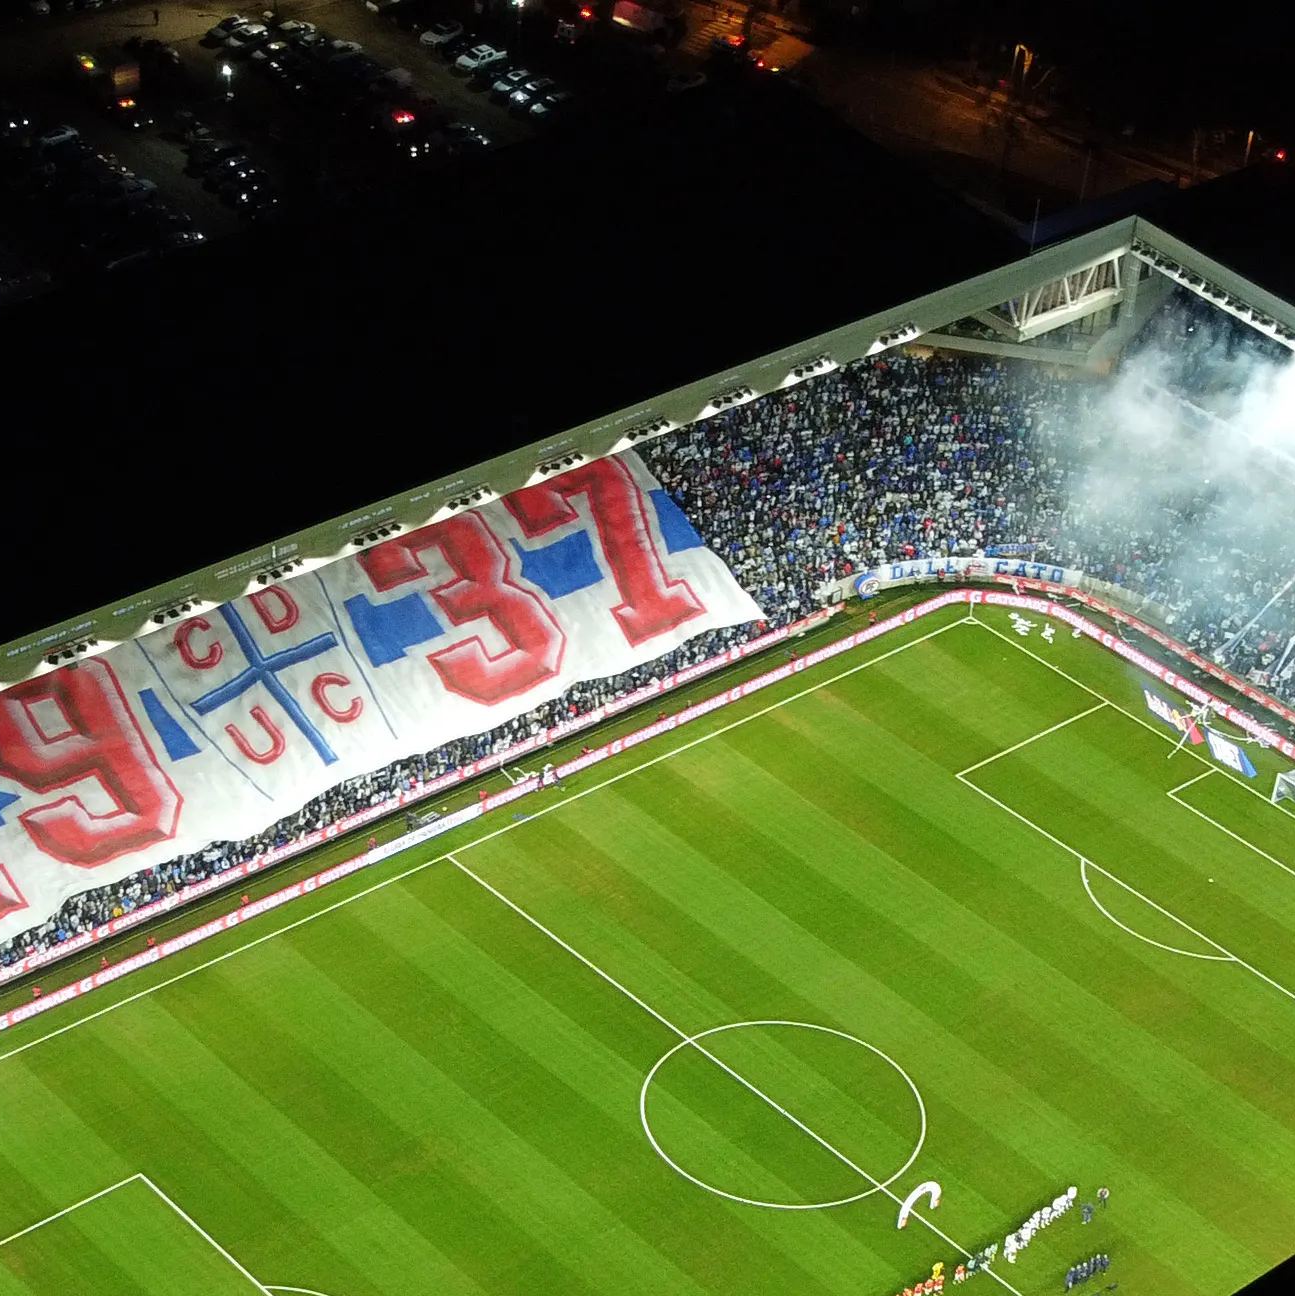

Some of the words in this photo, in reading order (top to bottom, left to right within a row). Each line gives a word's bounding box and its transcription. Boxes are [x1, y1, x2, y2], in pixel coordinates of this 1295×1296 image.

[969, 591, 982, 604] G
[1102, 630, 1114, 647] G
[1164, 670, 1176, 685] G
[77, 976, 95, 993] G
[223, 911, 241, 927] G
[301, 876, 319, 892] G
